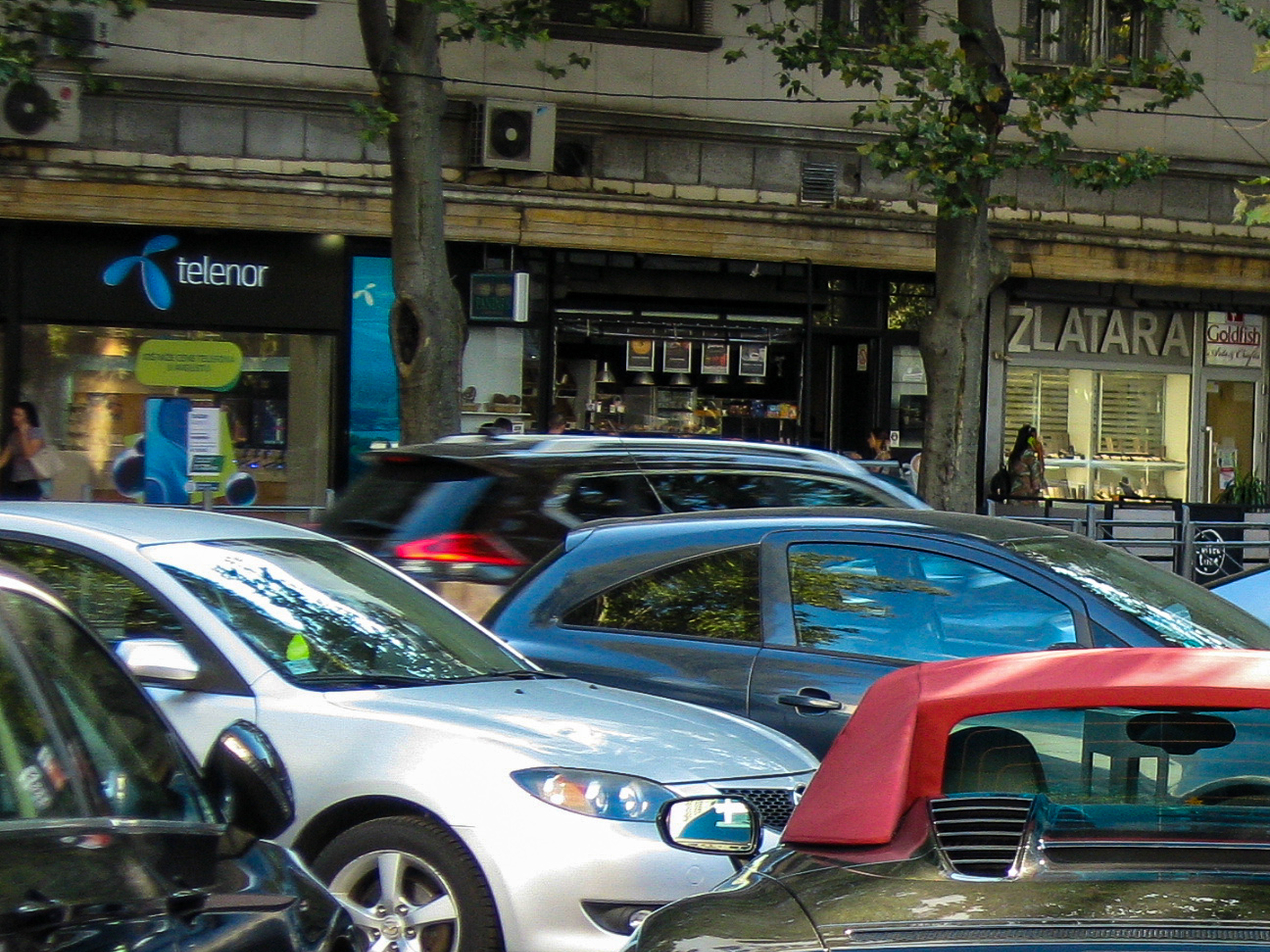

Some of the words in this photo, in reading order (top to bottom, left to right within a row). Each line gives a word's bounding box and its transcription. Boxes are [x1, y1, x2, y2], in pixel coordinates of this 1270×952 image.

[177, 255, 269, 287] telenor
[1008, 306, 1191, 358] ZLATARA
[1207, 324, 1261, 344] Goldfish
